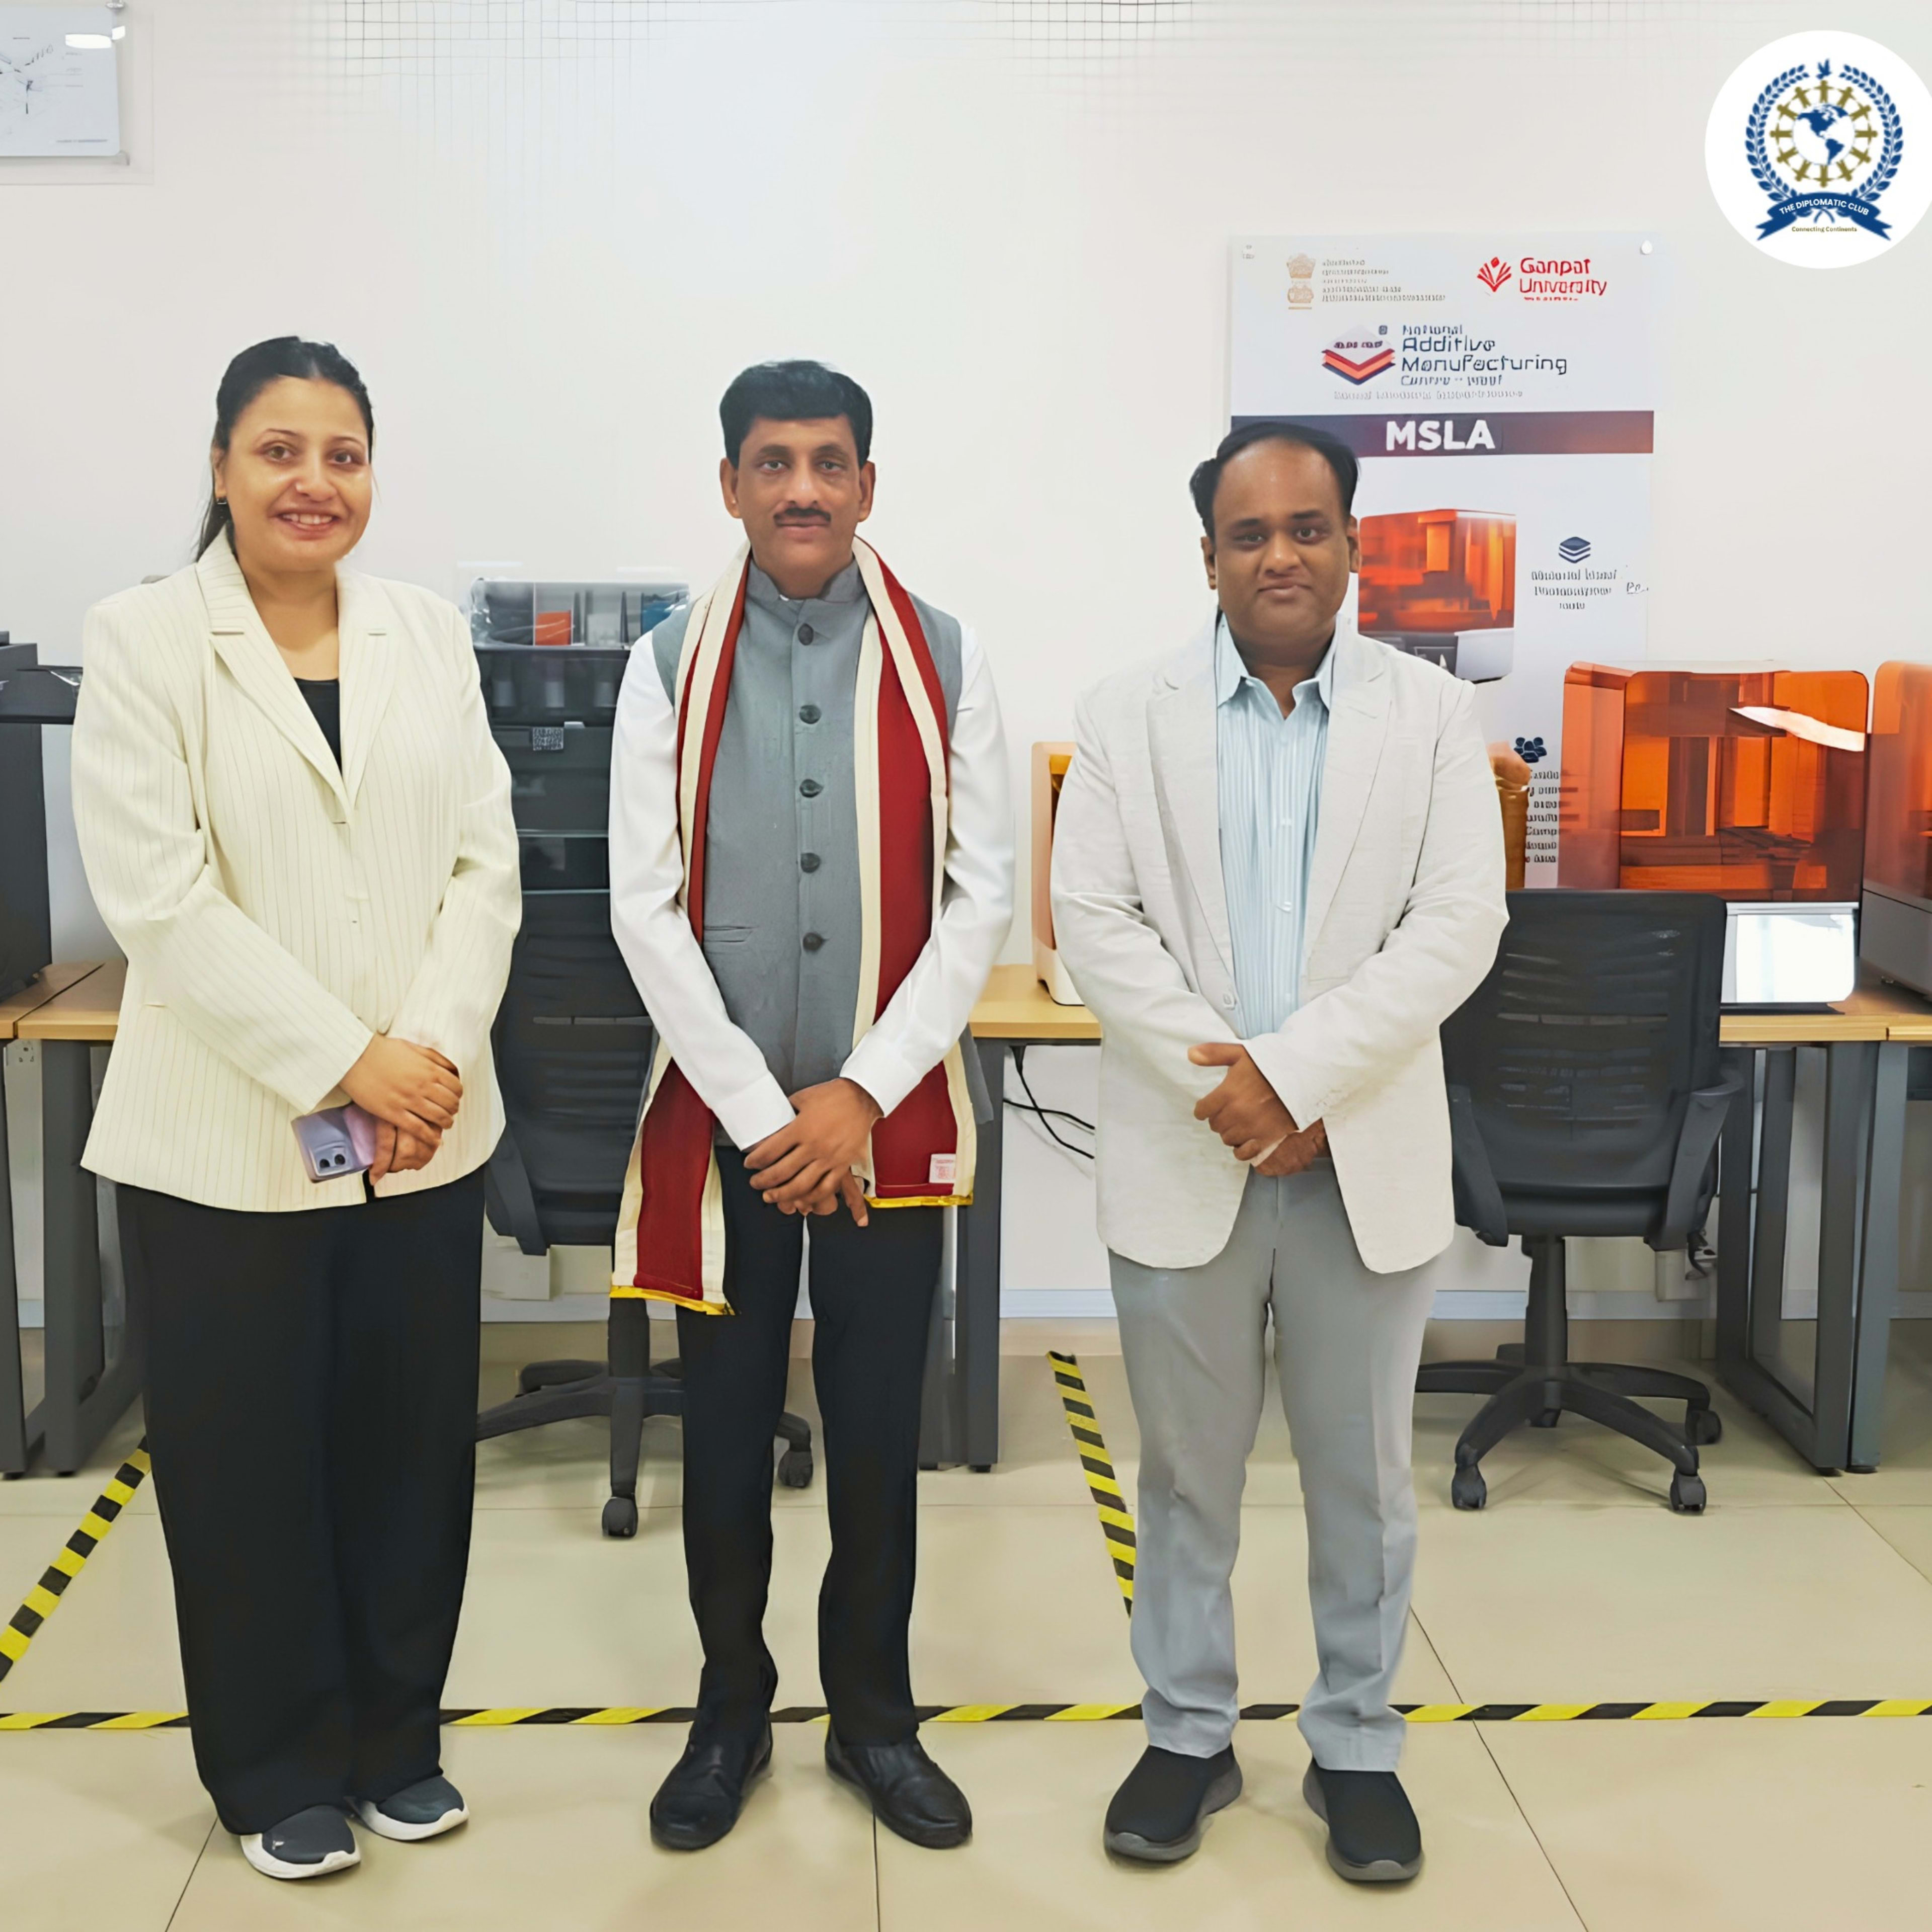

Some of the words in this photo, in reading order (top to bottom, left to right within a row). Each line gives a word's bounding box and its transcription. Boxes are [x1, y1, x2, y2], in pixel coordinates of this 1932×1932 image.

[1520, 257, 1590, 276] Ganpat
[1402, 354, 1567, 375] Manufacturing
[1385, 419, 1496, 451] MSLA
